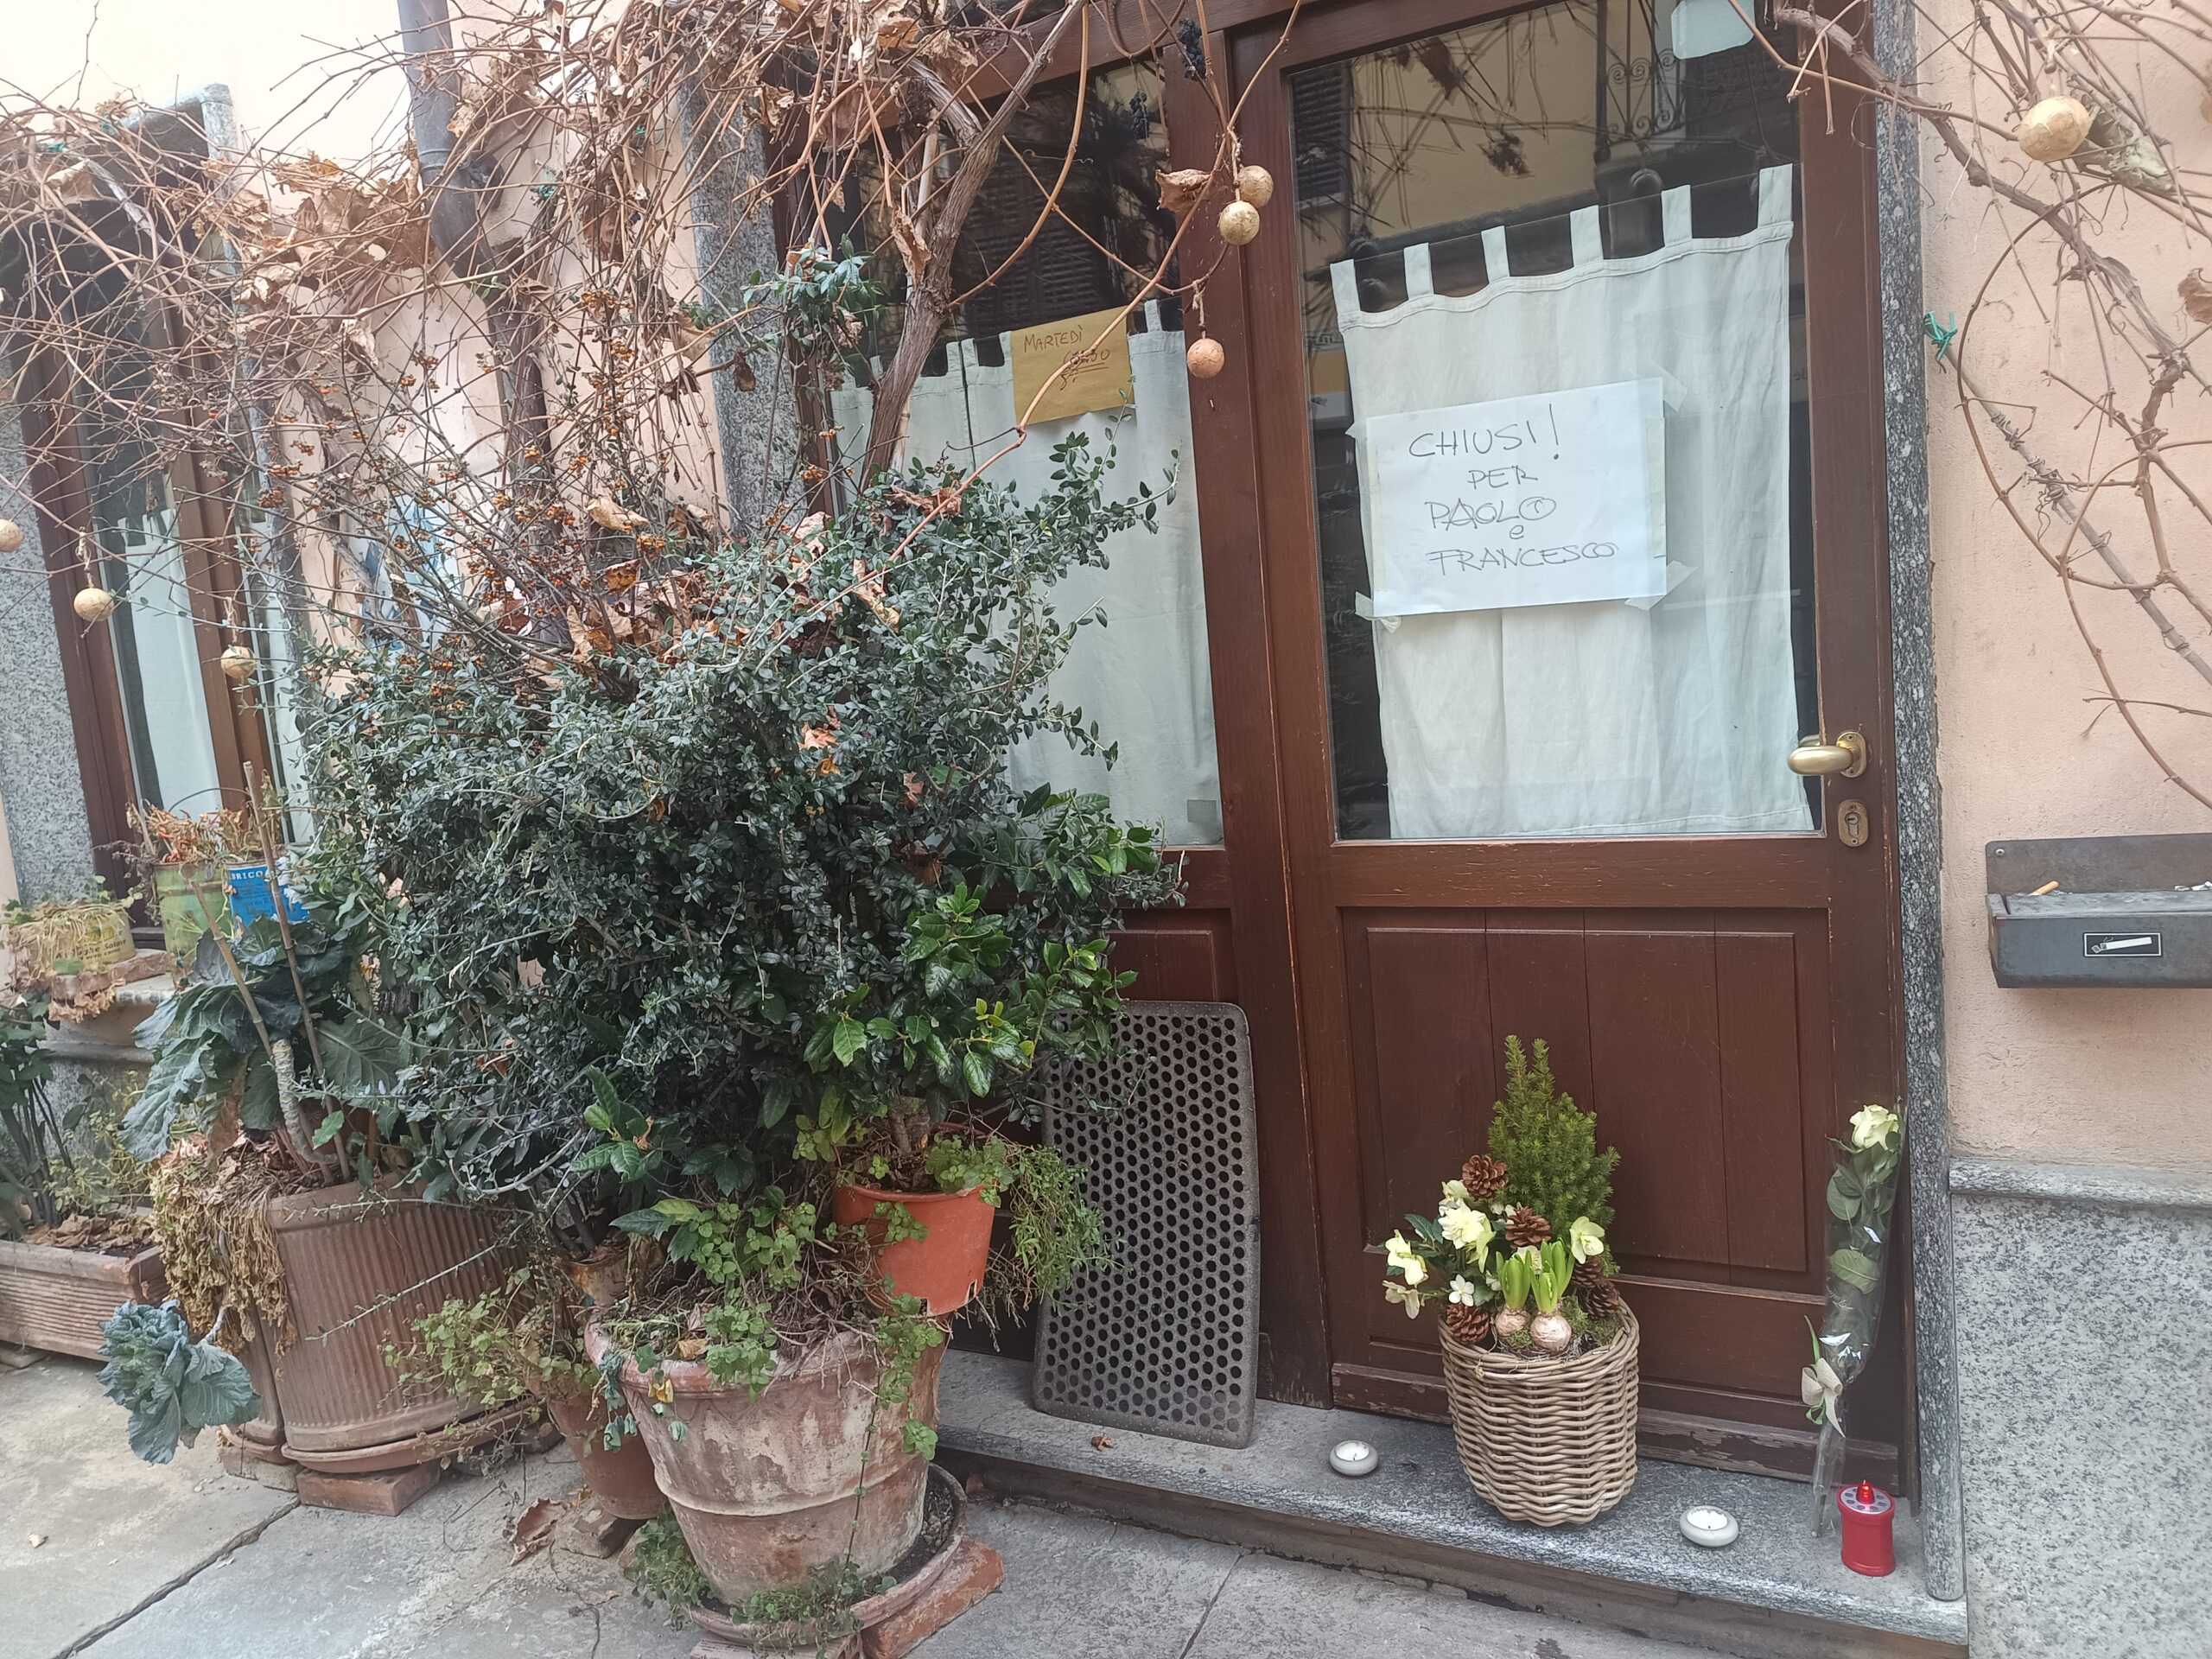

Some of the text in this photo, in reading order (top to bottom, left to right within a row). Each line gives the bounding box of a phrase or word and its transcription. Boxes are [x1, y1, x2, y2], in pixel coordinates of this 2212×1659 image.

[1467, 465, 1538, 490] PER
[1424, 496, 1557, 531] PAOLO
[1509, 524, 1525, 540] e
[1427, 541, 1618, 576] FRANCESCO
